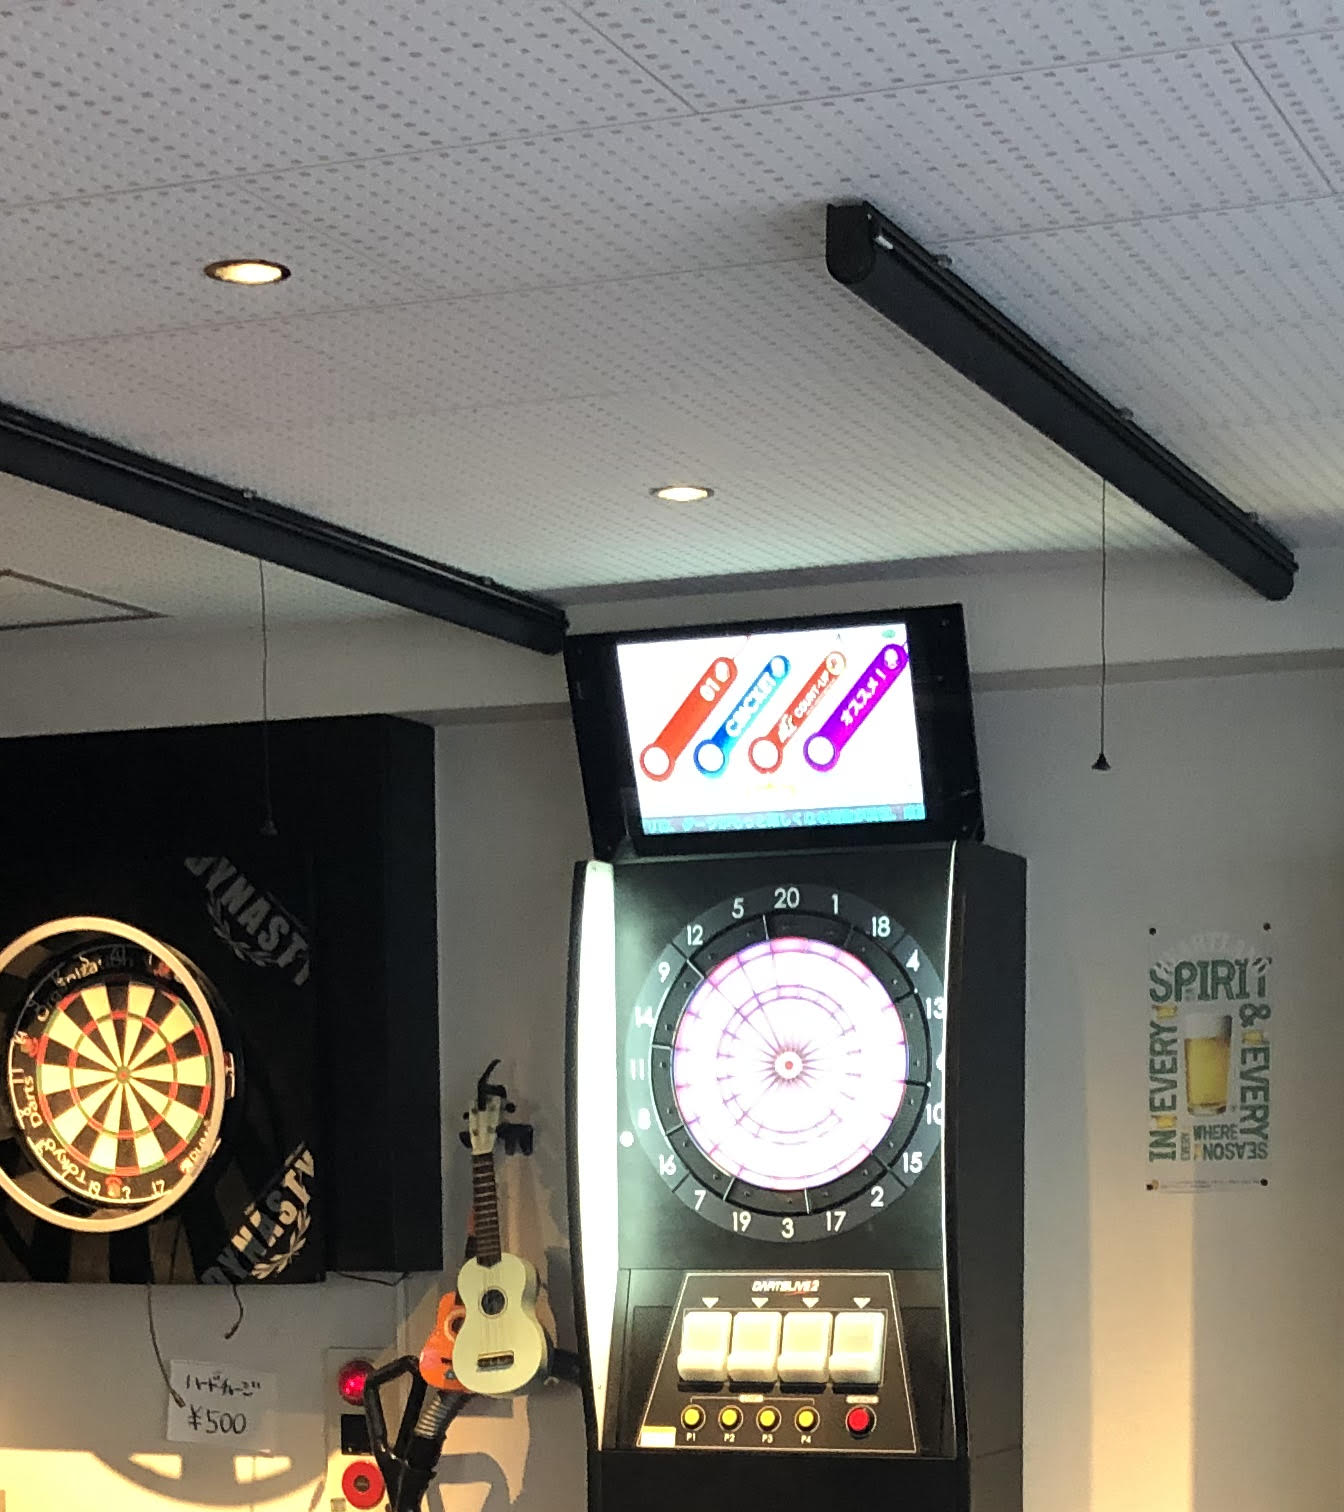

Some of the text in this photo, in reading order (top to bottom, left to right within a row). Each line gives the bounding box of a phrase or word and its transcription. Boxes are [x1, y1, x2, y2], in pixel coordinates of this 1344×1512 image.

[732, 898, 744, 917] 5
[775, 887, 800, 909] 20
[831, 895, 839, 914] 1
[686, 926, 704, 945] 12
[871, 917, 891, 937] 18
[906, 949, 920, 971] 4
[658, 962, 670, 981] 9
[1149, 957, 1272, 1004] SPIRIT
[634, 1007, 654, 1028] 14
[925, 998, 944, 1019] 13
[1239, 1003, 1271, 1028] &
[630, 1058, 645, 1079] 11
[1149, 1021, 1178, 1162] IN EVERY
[1239, 1045, 1270, 1139] EVERY
[638, 1108, 651, 1129] 8
[1193, 1124, 1239, 1141] WHERE
[902, 1151, 923, 1173] 15
[1202, 1142, 1269, 1161] SEASON
[658, 1154, 677, 1176] 16
[695, 1189, 707, 1211] 7
[870, 1187, 884, 1208] 2
[732, 1211, 752, 1232] 19
[782, 1218, 794, 1239] 3
[825, 1211, 846, 1232] 17
[686, 1432, 697, 1442] P1
[724, 1433, 735, 1443] P2
[762, 1433, 773, 1444] P3
[800, 1435, 812, 1445] P4
